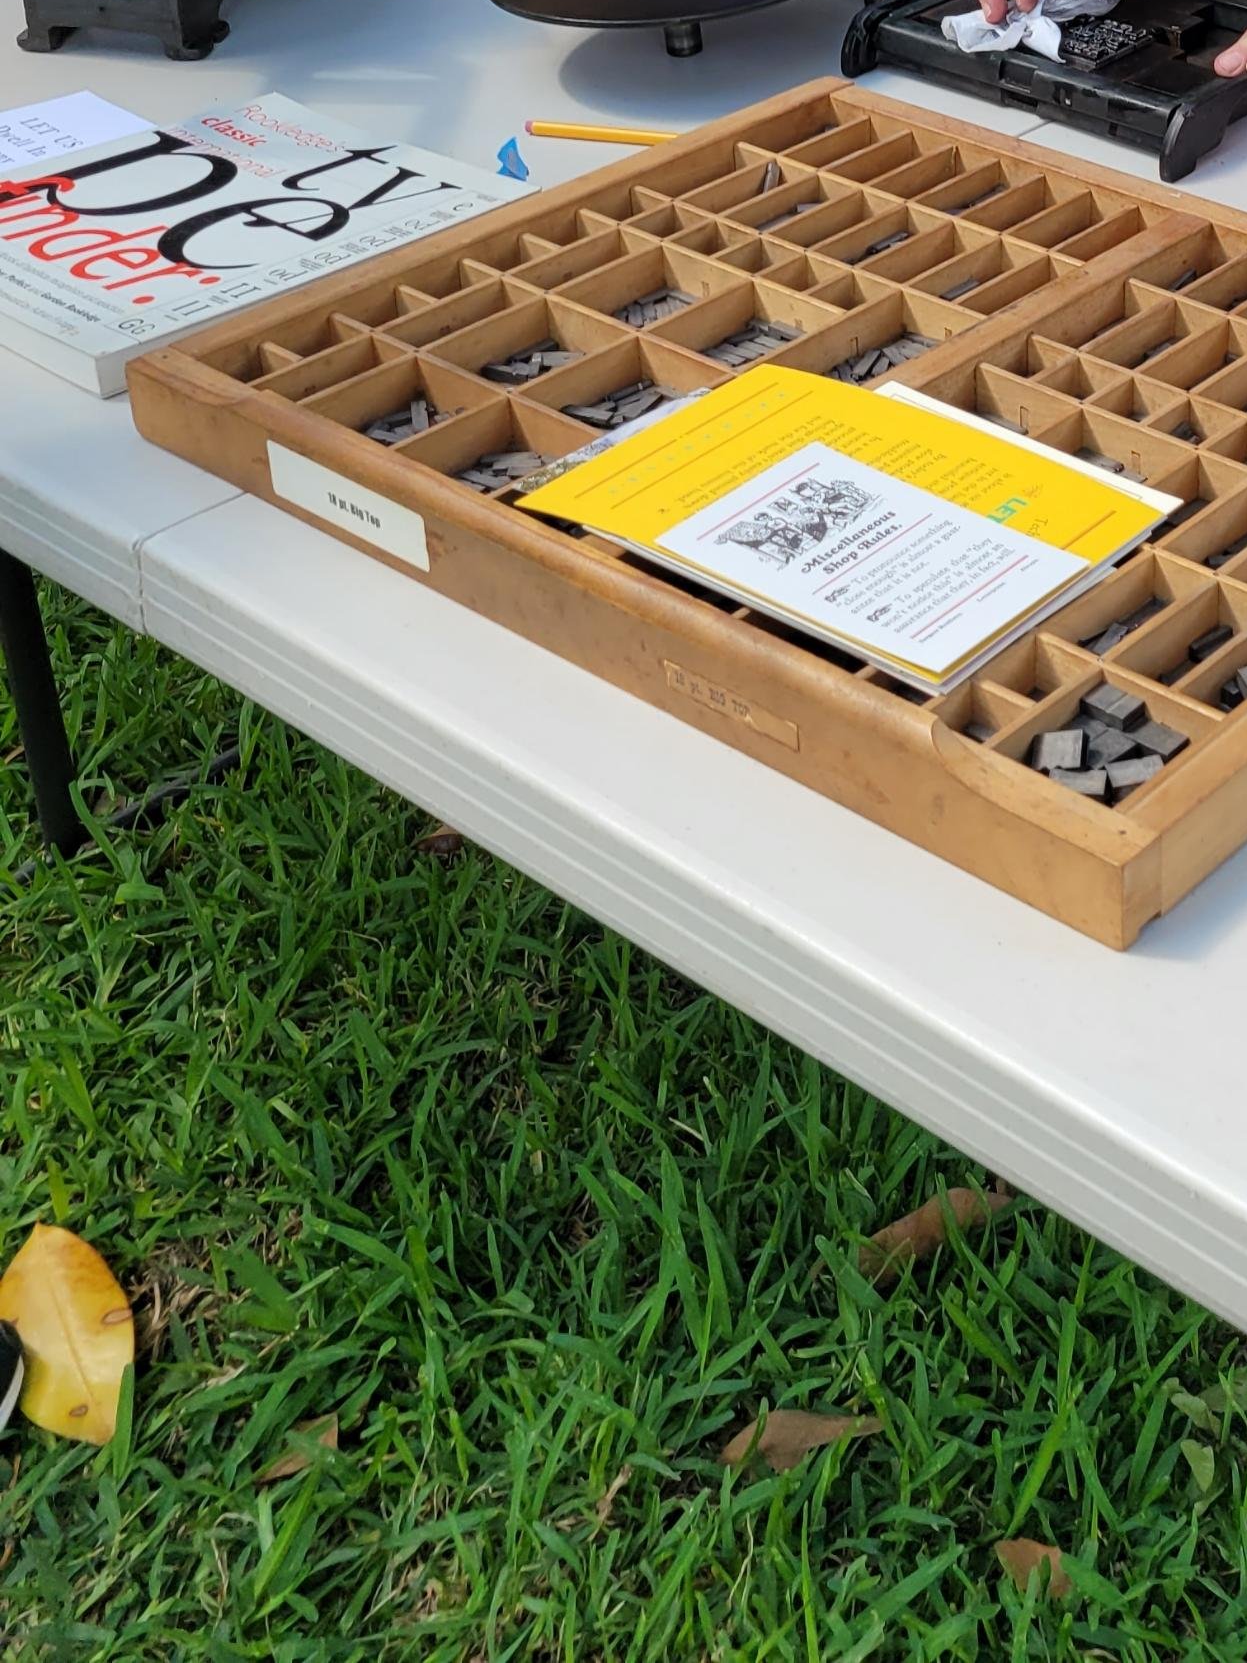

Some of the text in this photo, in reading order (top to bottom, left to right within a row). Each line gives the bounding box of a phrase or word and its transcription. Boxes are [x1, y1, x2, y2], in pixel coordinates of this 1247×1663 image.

[20, 117, 85, 149] LET US
[200, 115, 267, 148] classic
[164, 125, 291, 181] international
[350, 503, 364, 521] Big
[364, 510, 381, 528] Top
[801, 511, 896, 575] Miscellaneous
[822, 524, 903, 575] Shop Rules.
